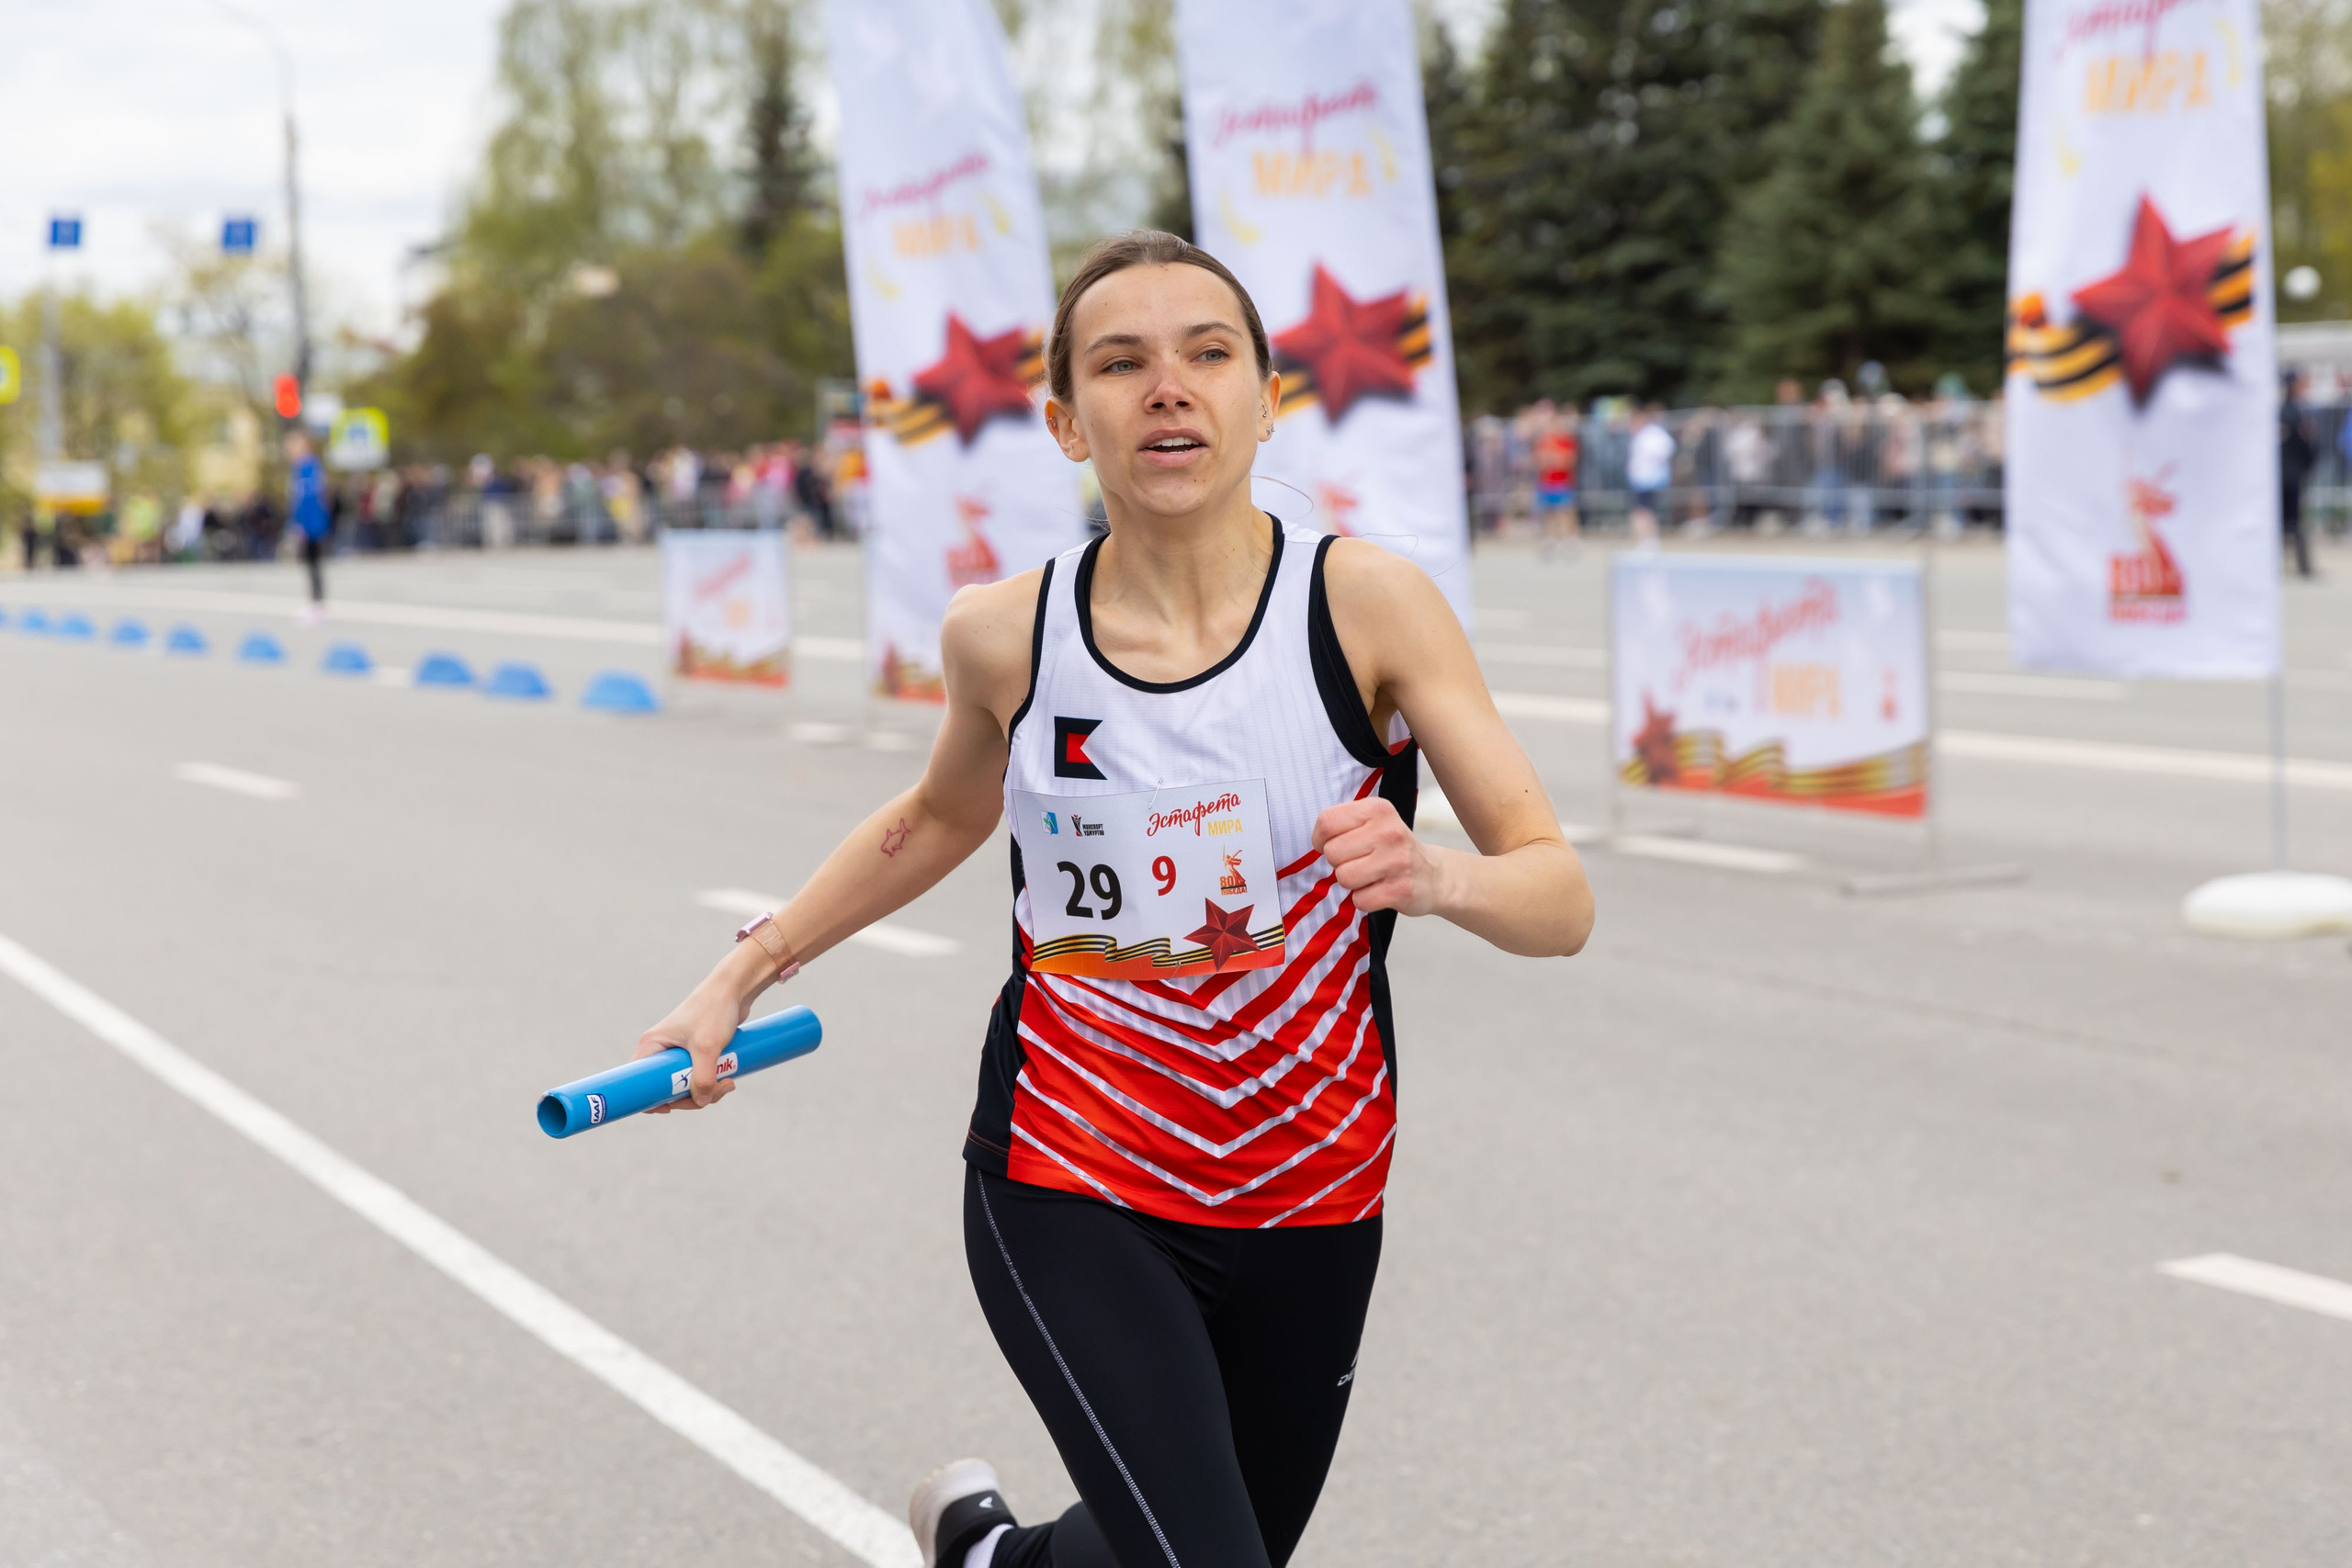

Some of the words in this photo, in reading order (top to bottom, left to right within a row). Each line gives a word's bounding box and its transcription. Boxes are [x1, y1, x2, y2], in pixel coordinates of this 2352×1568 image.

[1147, 793, 1242, 837] Эстафета
[1207, 818, 1244, 837] МИРА
[1057, 861, 1123, 920] 29
[1151, 855, 1177, 897] 9
